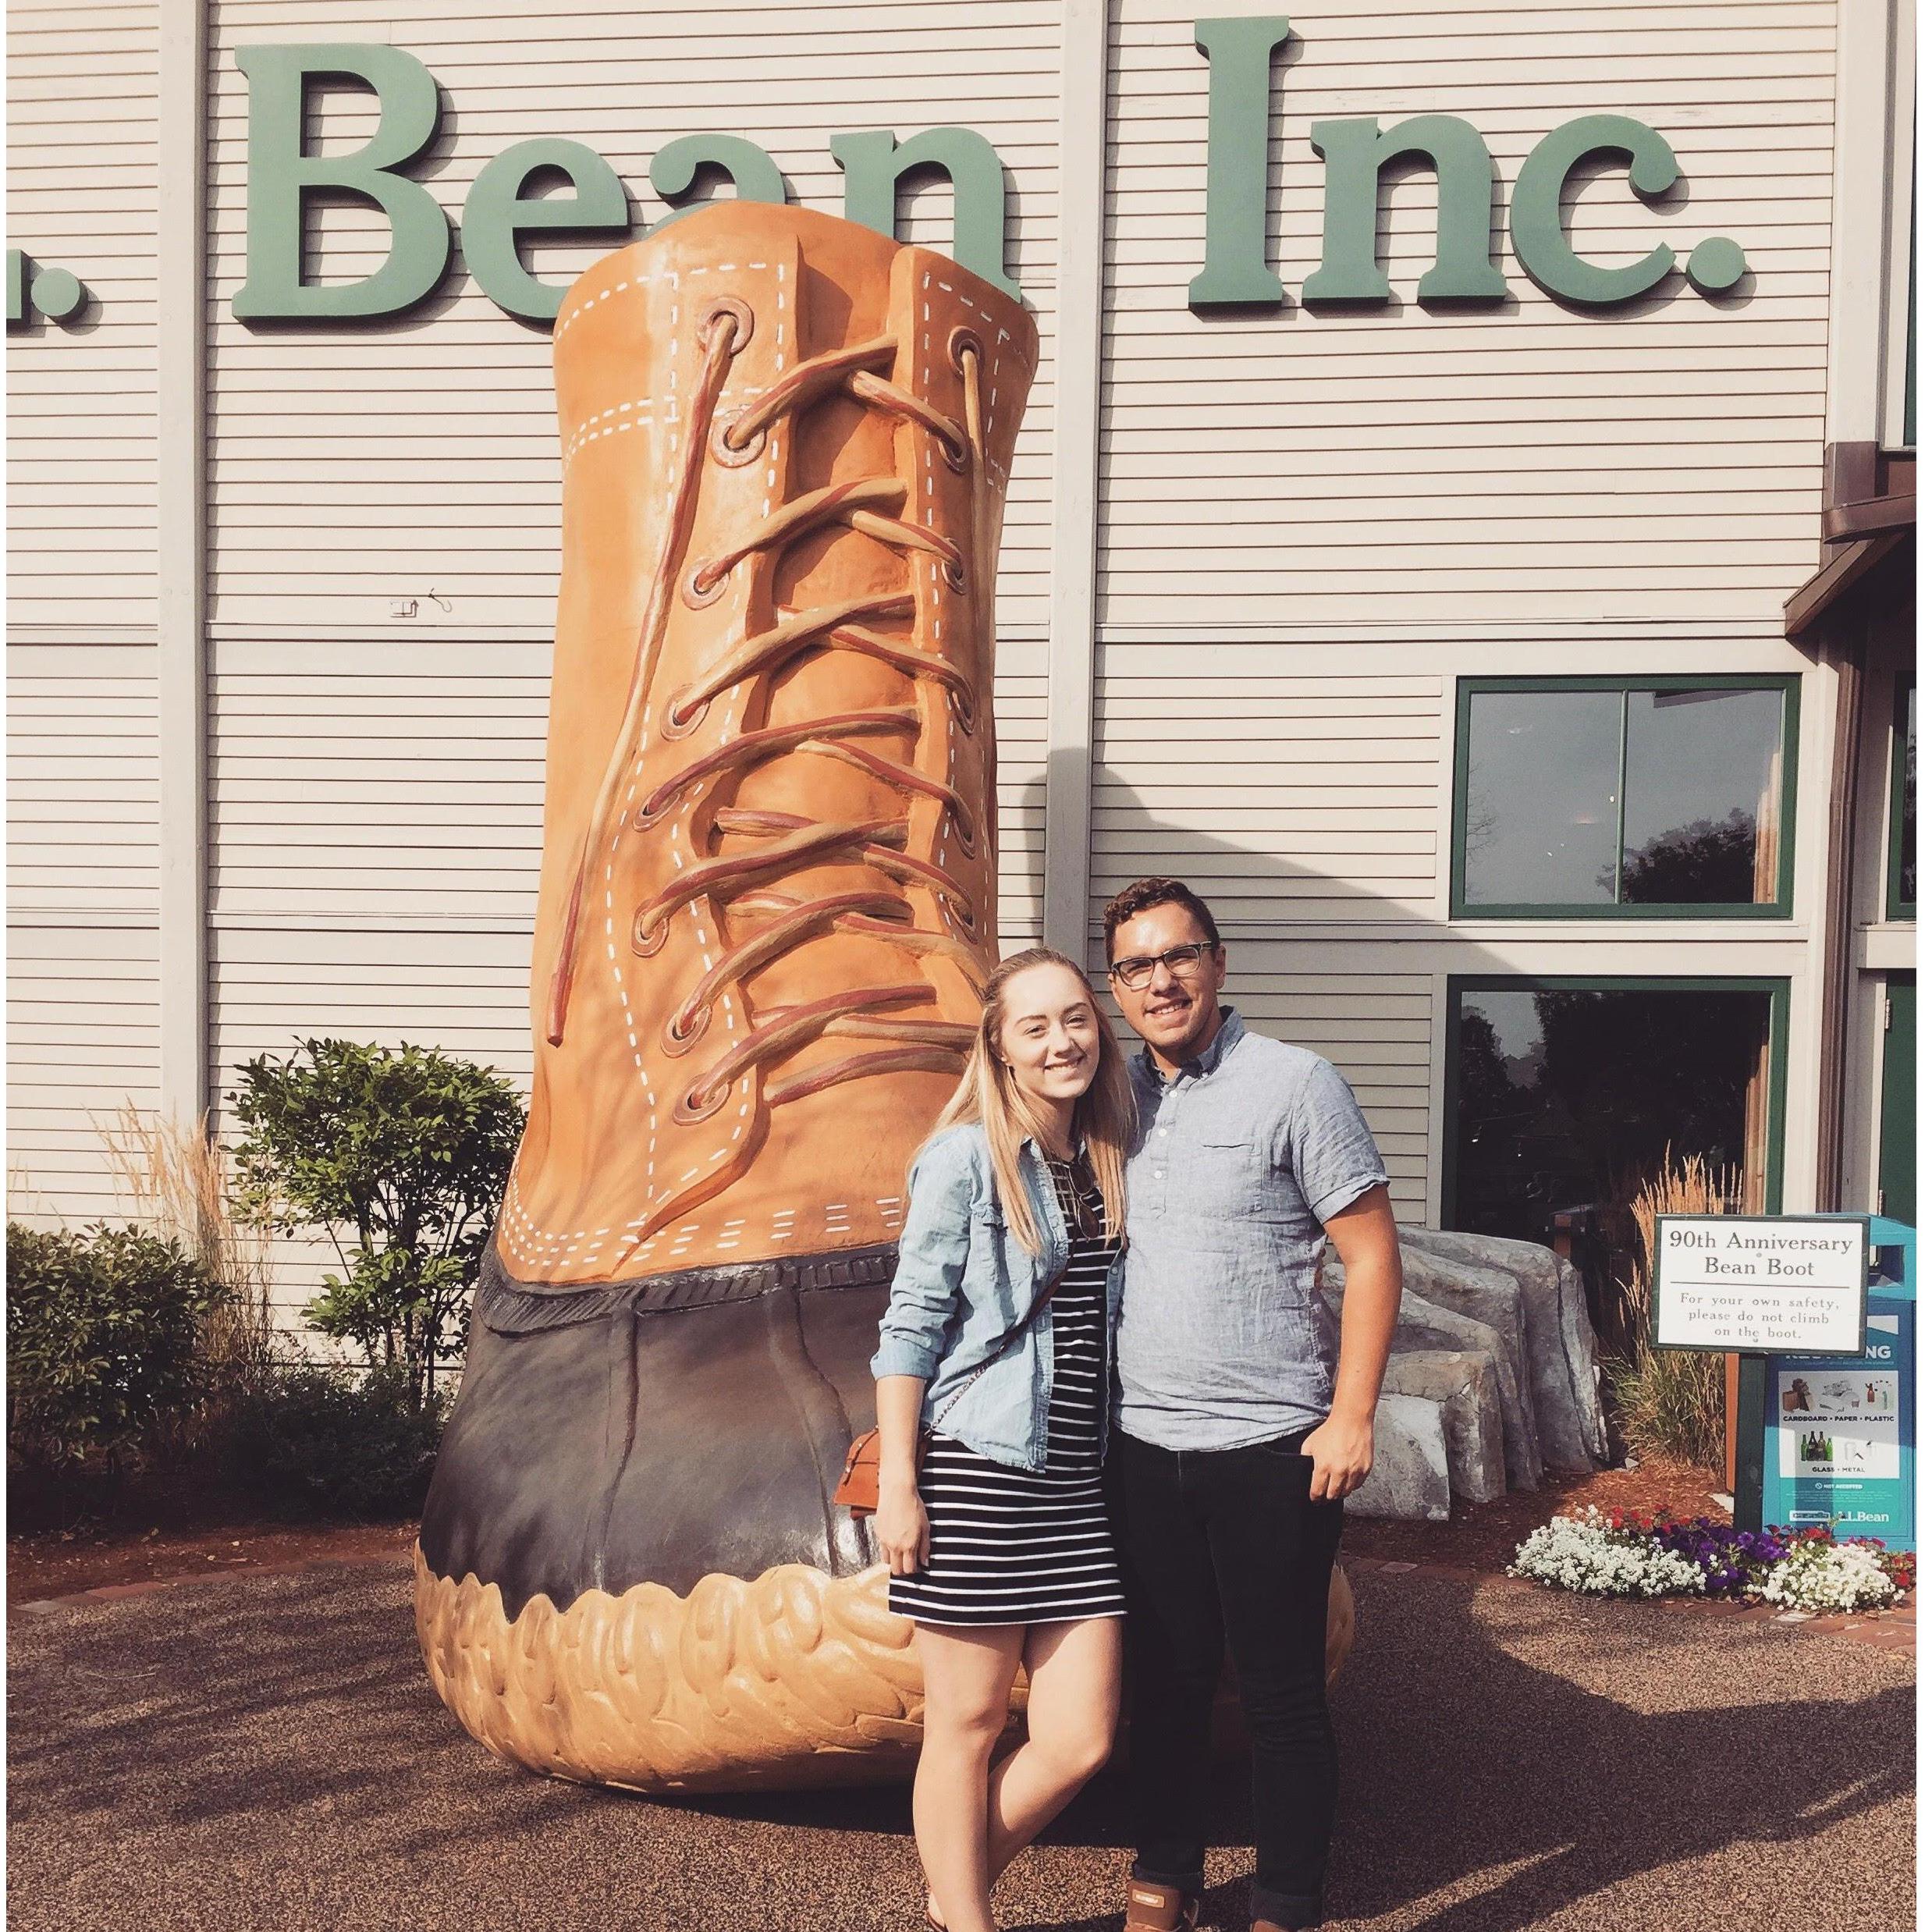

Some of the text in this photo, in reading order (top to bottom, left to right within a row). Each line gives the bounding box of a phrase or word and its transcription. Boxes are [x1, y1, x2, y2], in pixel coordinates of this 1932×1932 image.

[1188, 16, 1746, 309] Inc.
[1669, 1231, 1853, 1255] 90th Anniversary
[1705, 1256, 1815, 1276] Bean Boot
[1681, 1292, 1840, 1311] For your own safety,
[1689, 1309, 1830, 1324] please do not climb
[1714, 1326, 1802, 1339] on the boot.
